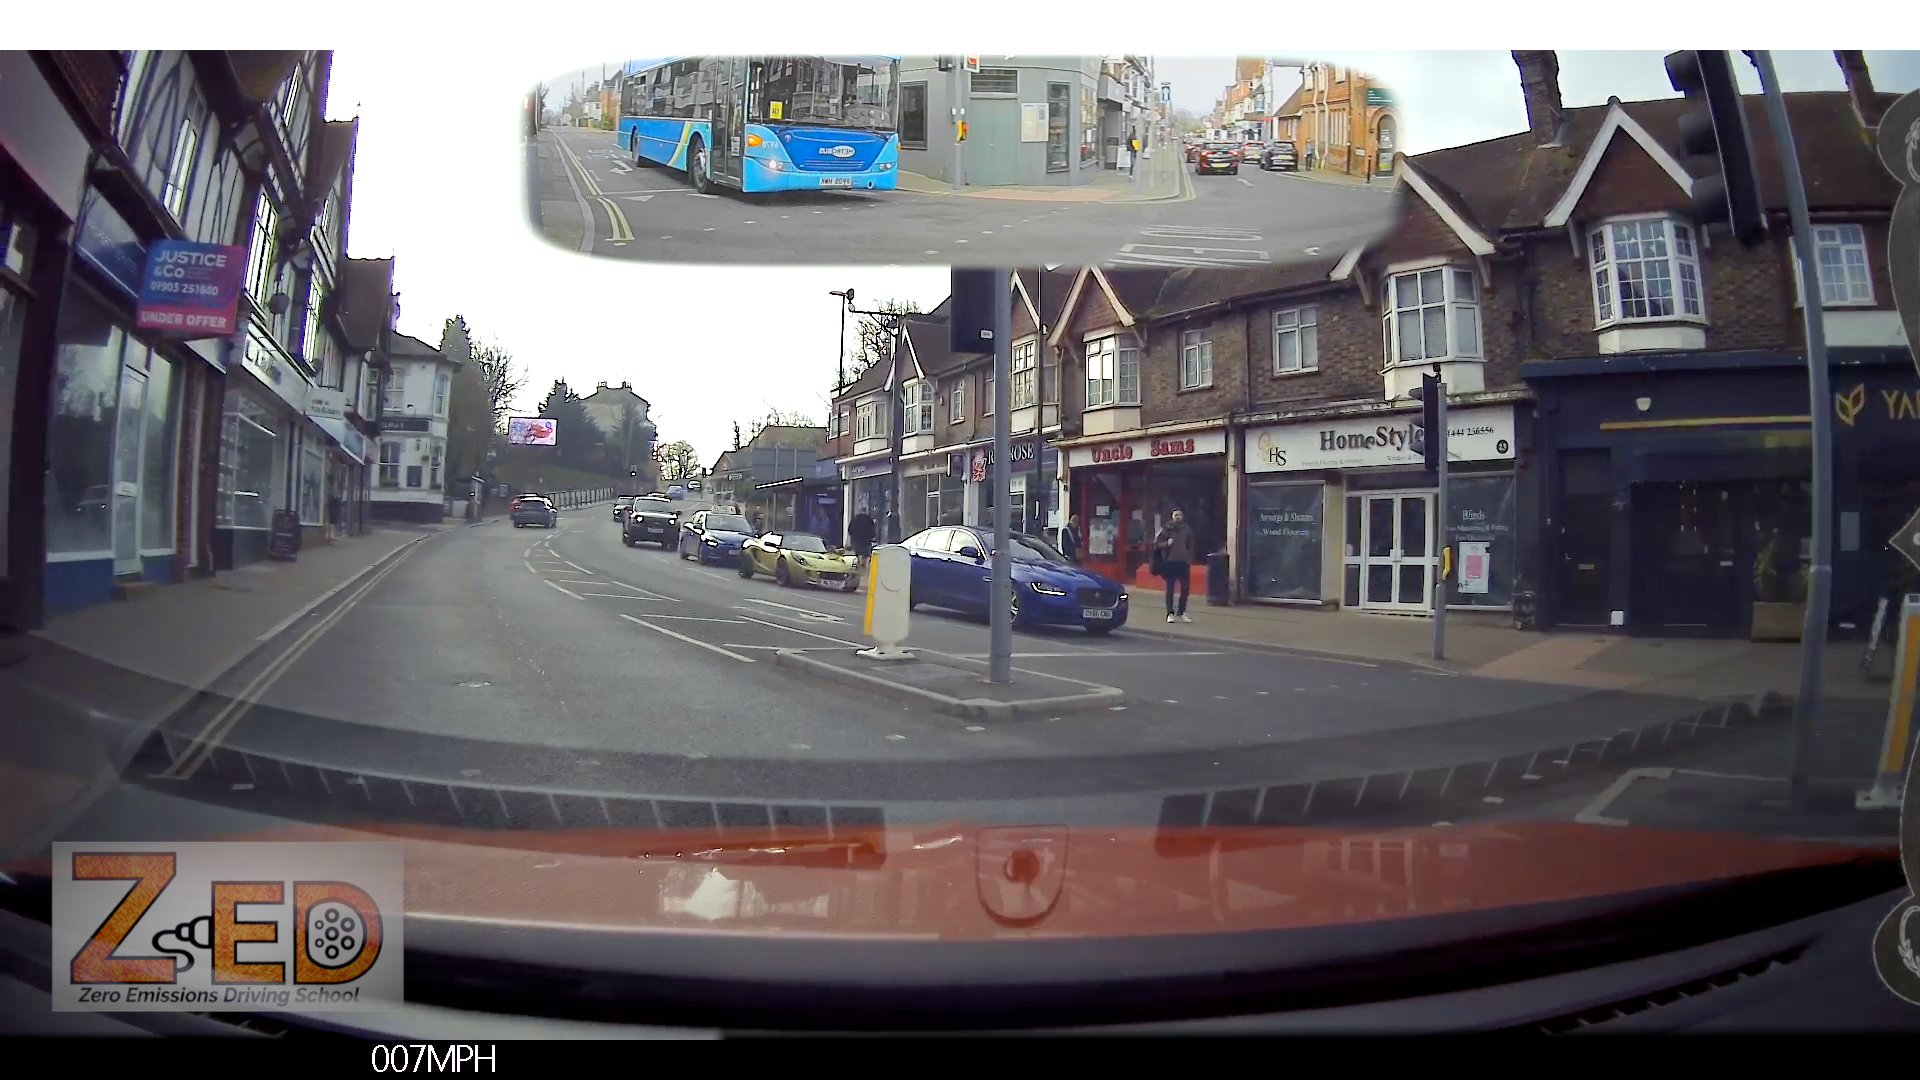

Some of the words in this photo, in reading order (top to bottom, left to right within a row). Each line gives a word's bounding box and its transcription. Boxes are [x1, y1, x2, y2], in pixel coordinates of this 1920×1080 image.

[156, 249, 227, 268] JUSTICE
[153, 265, 185, 278] &Co
[151, 281, 180, 293] 01903
[181, 283, 219, 296] 251600
[141, 310, 183, 325] UNDER
[186, 315, 226, 329] OFFER
[1319, 425, 1424, 452] HomeStyle
[1091, 444, 1133, 463] Uncle
[1150, 438, 1195, 457] Sams
